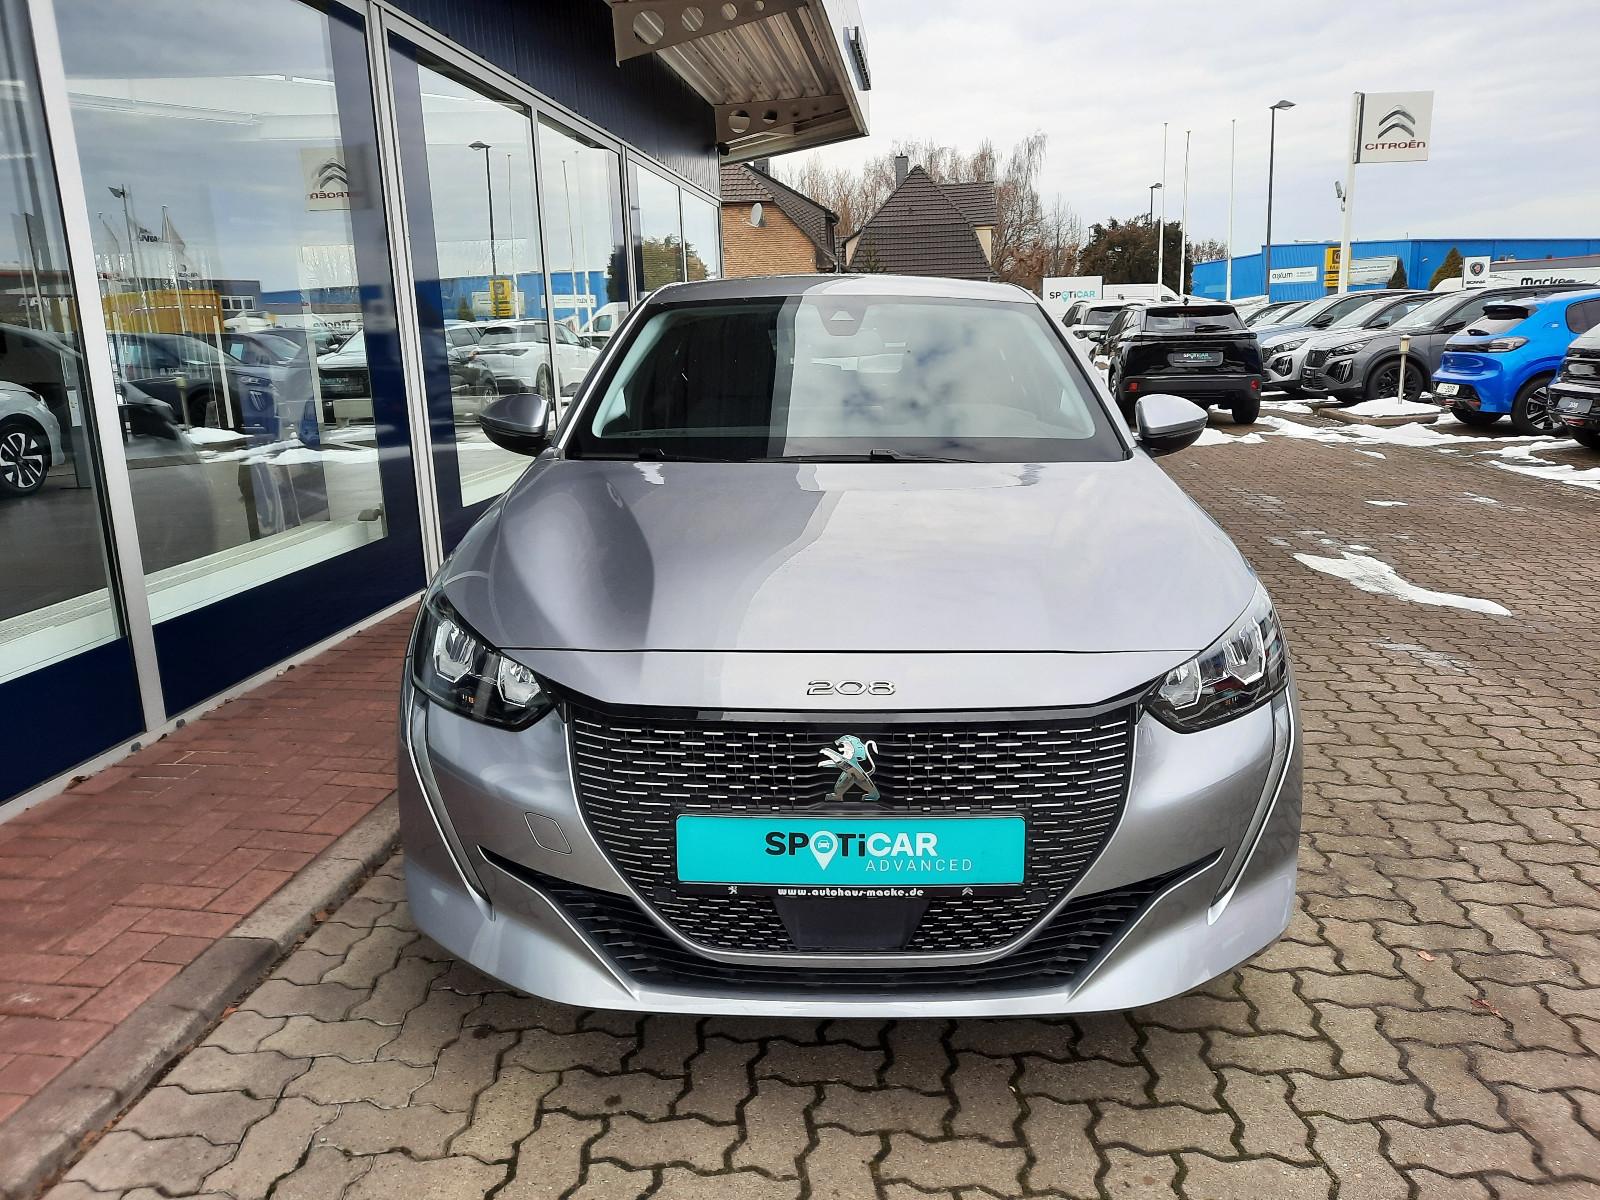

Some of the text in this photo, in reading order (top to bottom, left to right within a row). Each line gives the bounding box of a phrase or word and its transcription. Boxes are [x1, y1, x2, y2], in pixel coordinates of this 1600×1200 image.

[806, 680, 897, 696] 208
[865, 859, 973, 872] ADVANCED
[777, 887, 925, 898] www.autohaus-macke.de
